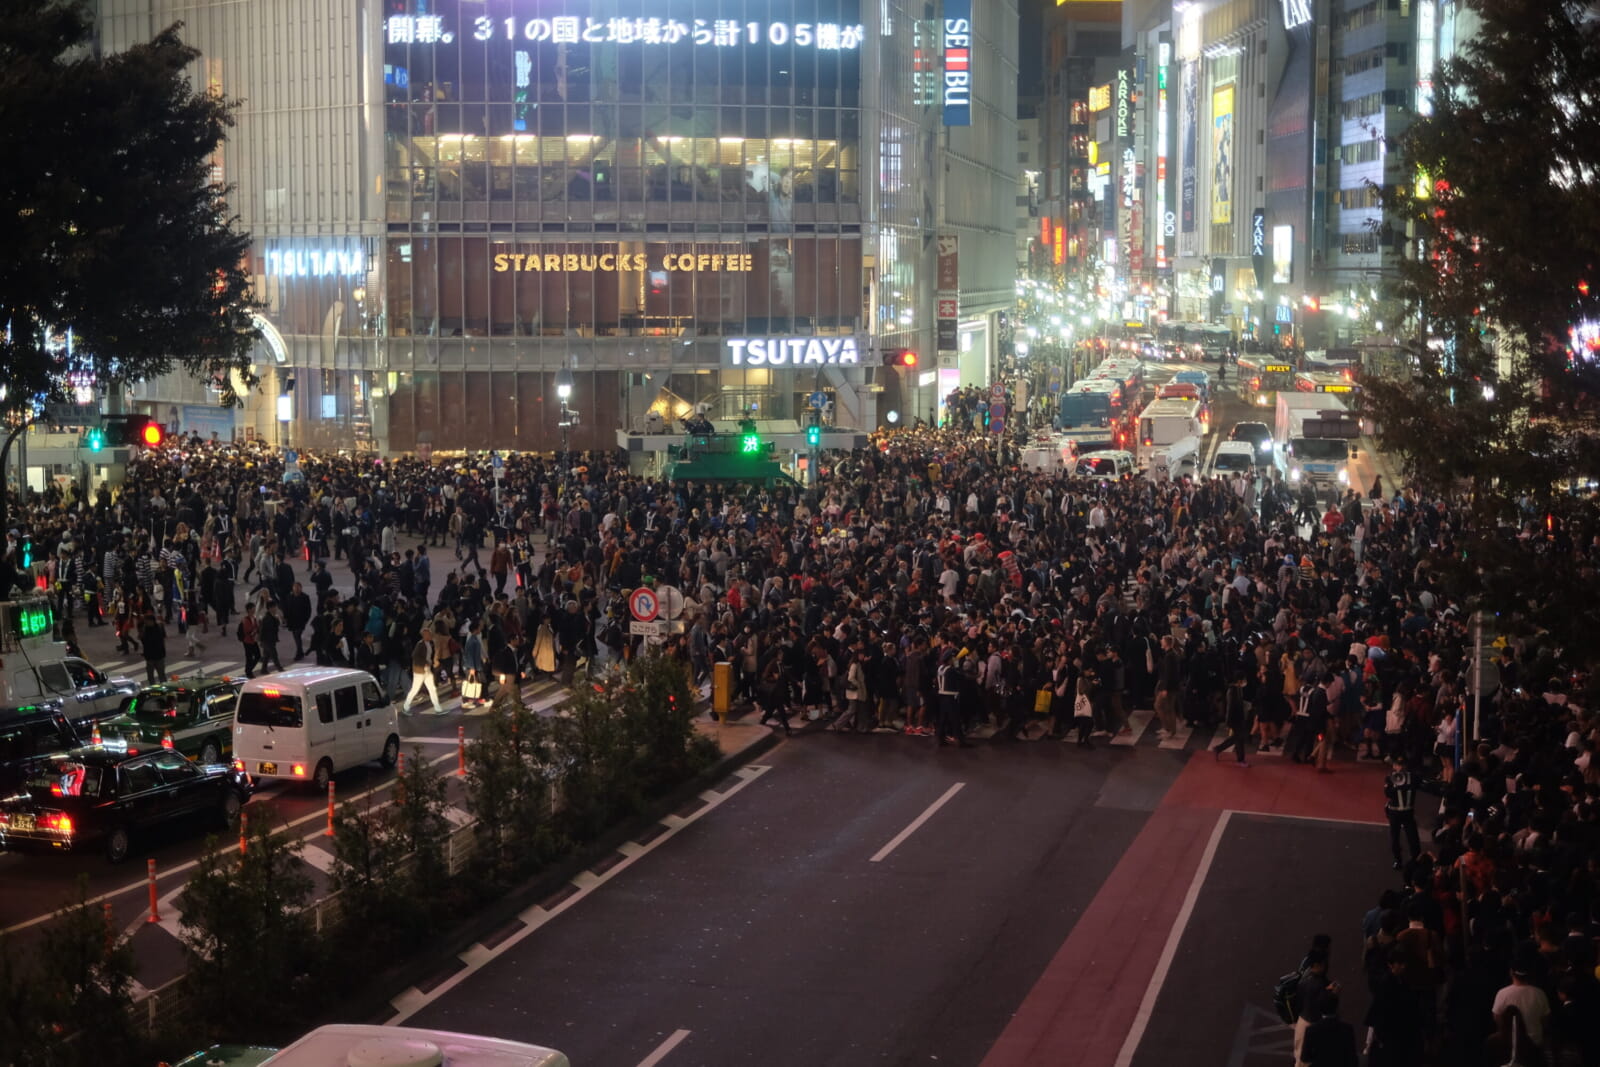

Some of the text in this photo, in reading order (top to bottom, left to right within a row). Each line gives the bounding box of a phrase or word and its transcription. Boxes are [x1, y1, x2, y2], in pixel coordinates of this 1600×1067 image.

[945, 18, 969, 106] SEIBU
[1117, 69, 1128, 137] KARAOKE
[1253, 215, 1264, 256] ZARA
[266, 249, 363, 276] TSUTAYA
[493, 253, 753, 273] STARBUCKS COFFEE
[727, 338, 858, 366] TSUTAYA
[631, 624, 657, 633] ここから
